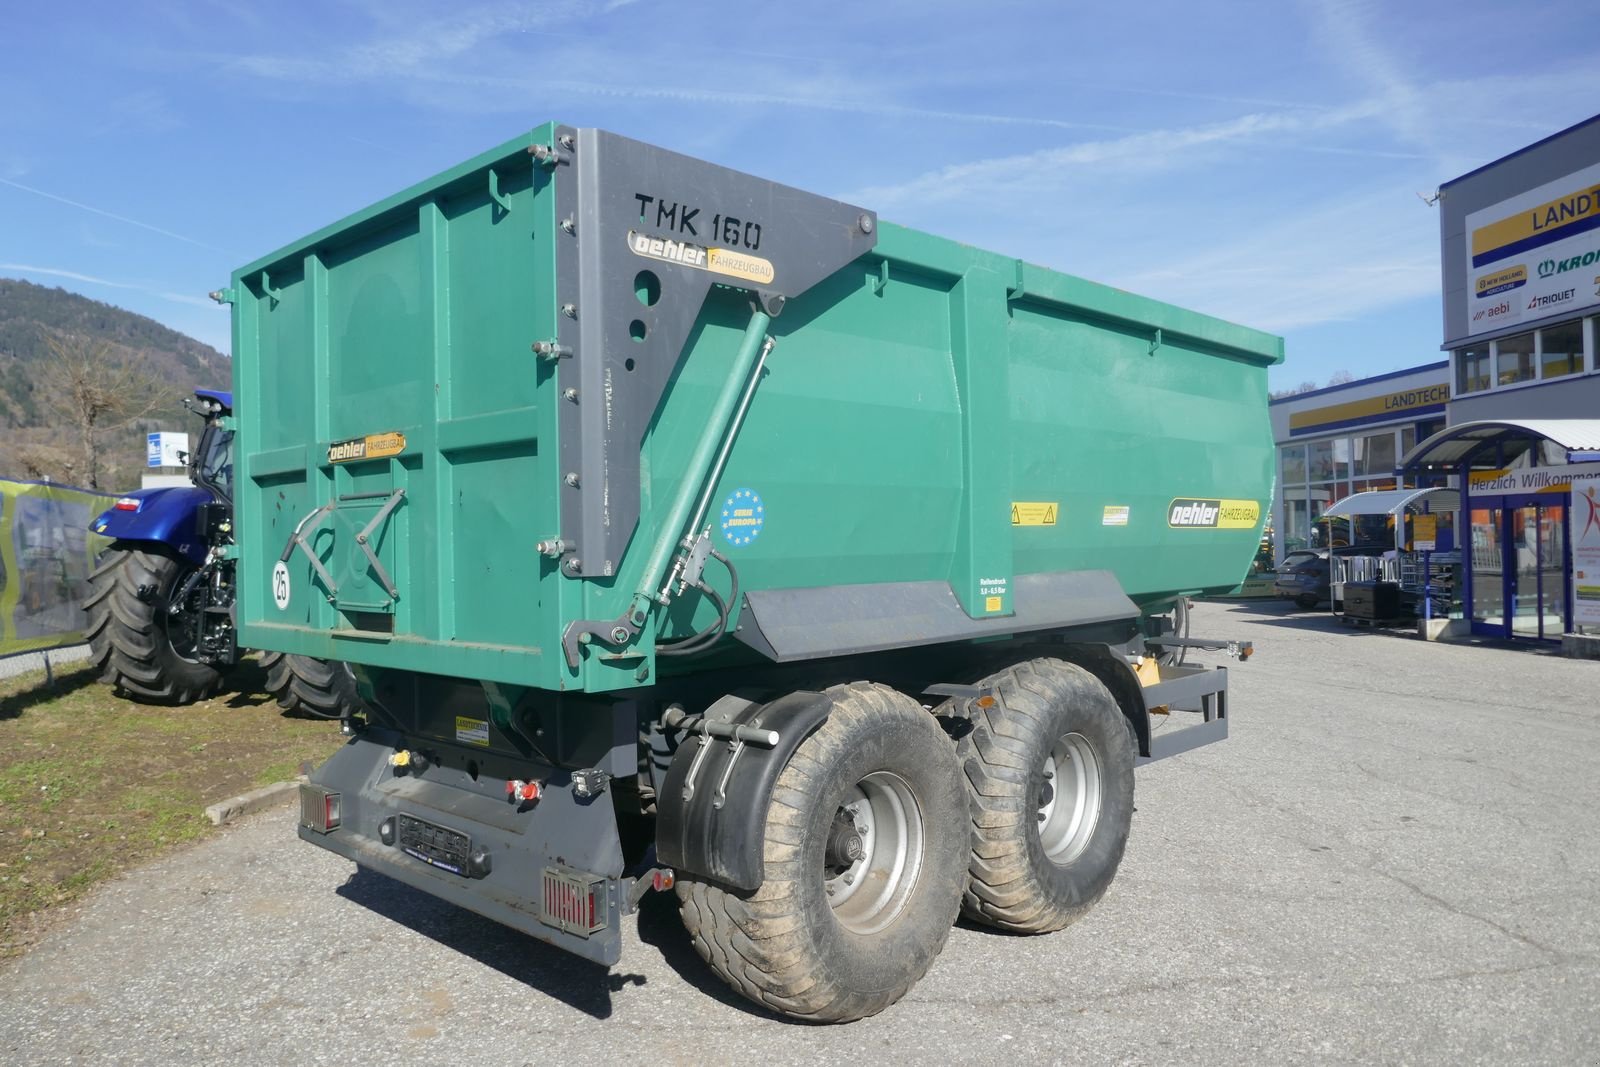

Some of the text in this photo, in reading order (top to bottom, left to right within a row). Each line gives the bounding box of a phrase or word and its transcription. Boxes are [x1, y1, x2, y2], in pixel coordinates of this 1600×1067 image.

[635, 193, 761, 250] TMK 160
[634, 235, 772, 277] oehler FAHRZEUGBAU
[1486, 270, 1523, 286] NEW HOLLAND
[1486, 283, 1515, 295] AGRICULTURE
[1537, 288, 1576, 306] TRIOLIET
[1488, 301, 1510, 317] aebi
[1385, 385, 1450, 409] LANDTECH
[330, 437, 403, 460] oehler FAHRZEUGBAU
[1471, 475, 1516, 491] Herzlich
[728, 518, 757, 526] EUROPA
[1171, 502, 1257, 525] oehler FAHRZEUGBAU
[275, 570, 286, 600] 25
